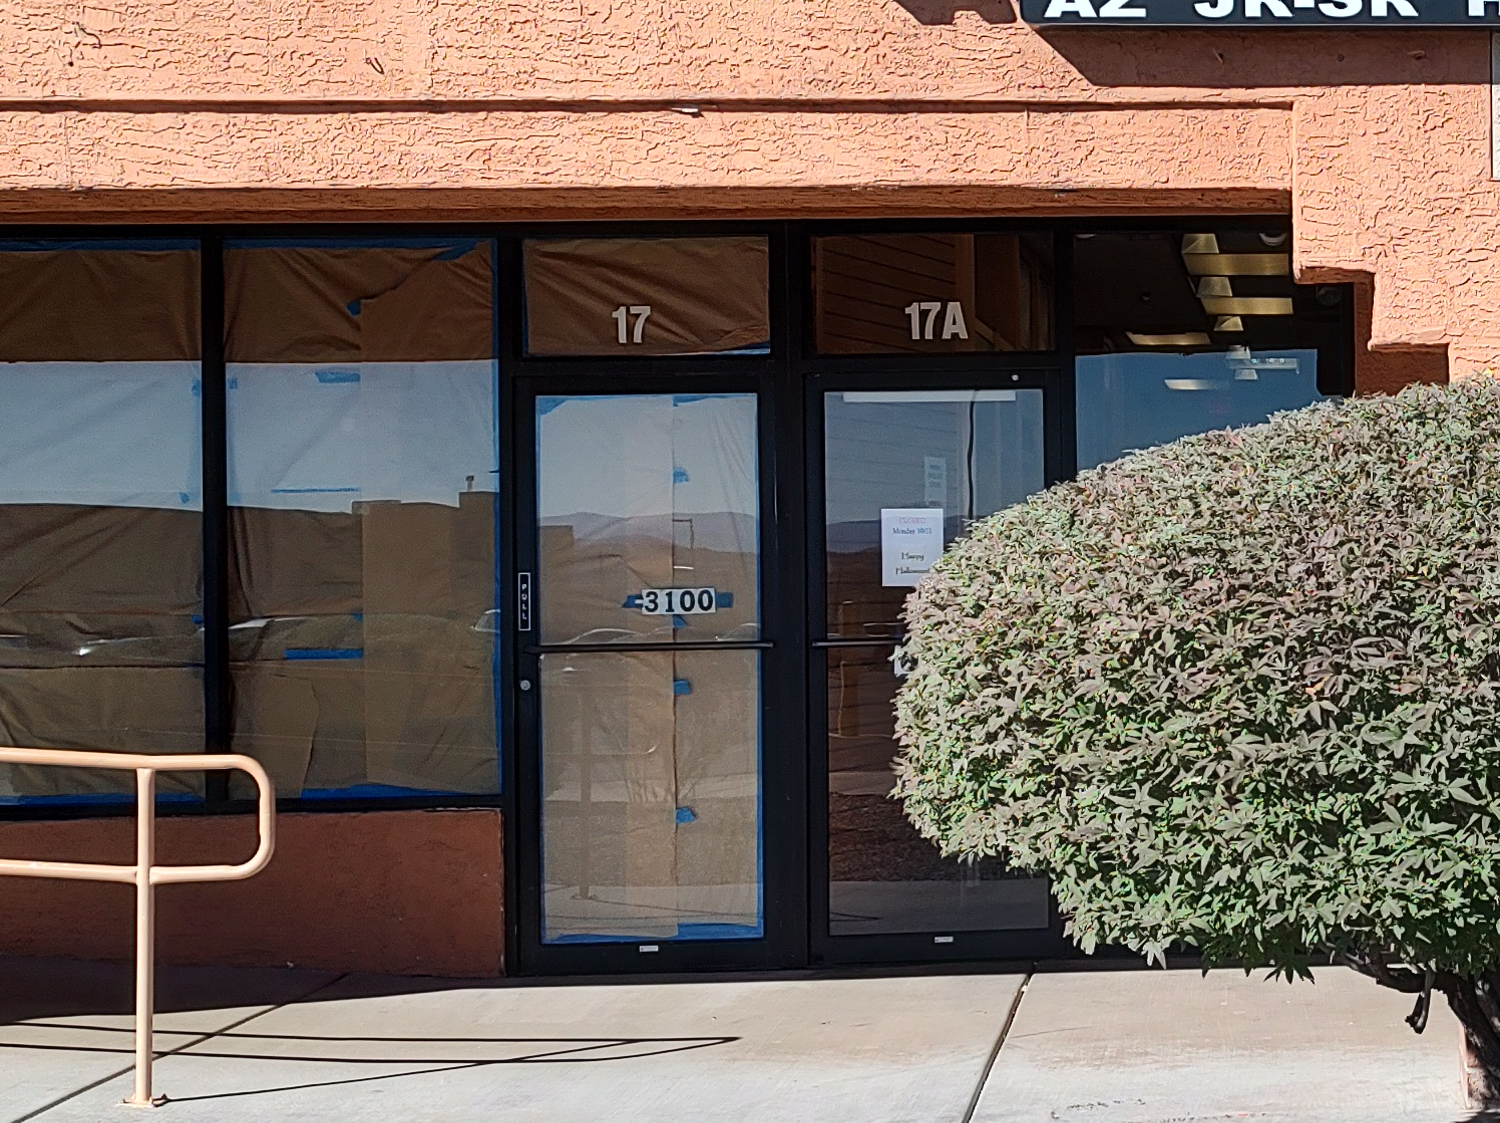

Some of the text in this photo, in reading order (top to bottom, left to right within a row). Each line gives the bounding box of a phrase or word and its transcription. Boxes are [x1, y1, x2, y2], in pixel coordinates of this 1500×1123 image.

[612, 305, 652, 344] 17
[905, 301, 968, 341] 17A
[644, 589, 714, 613] 3100
